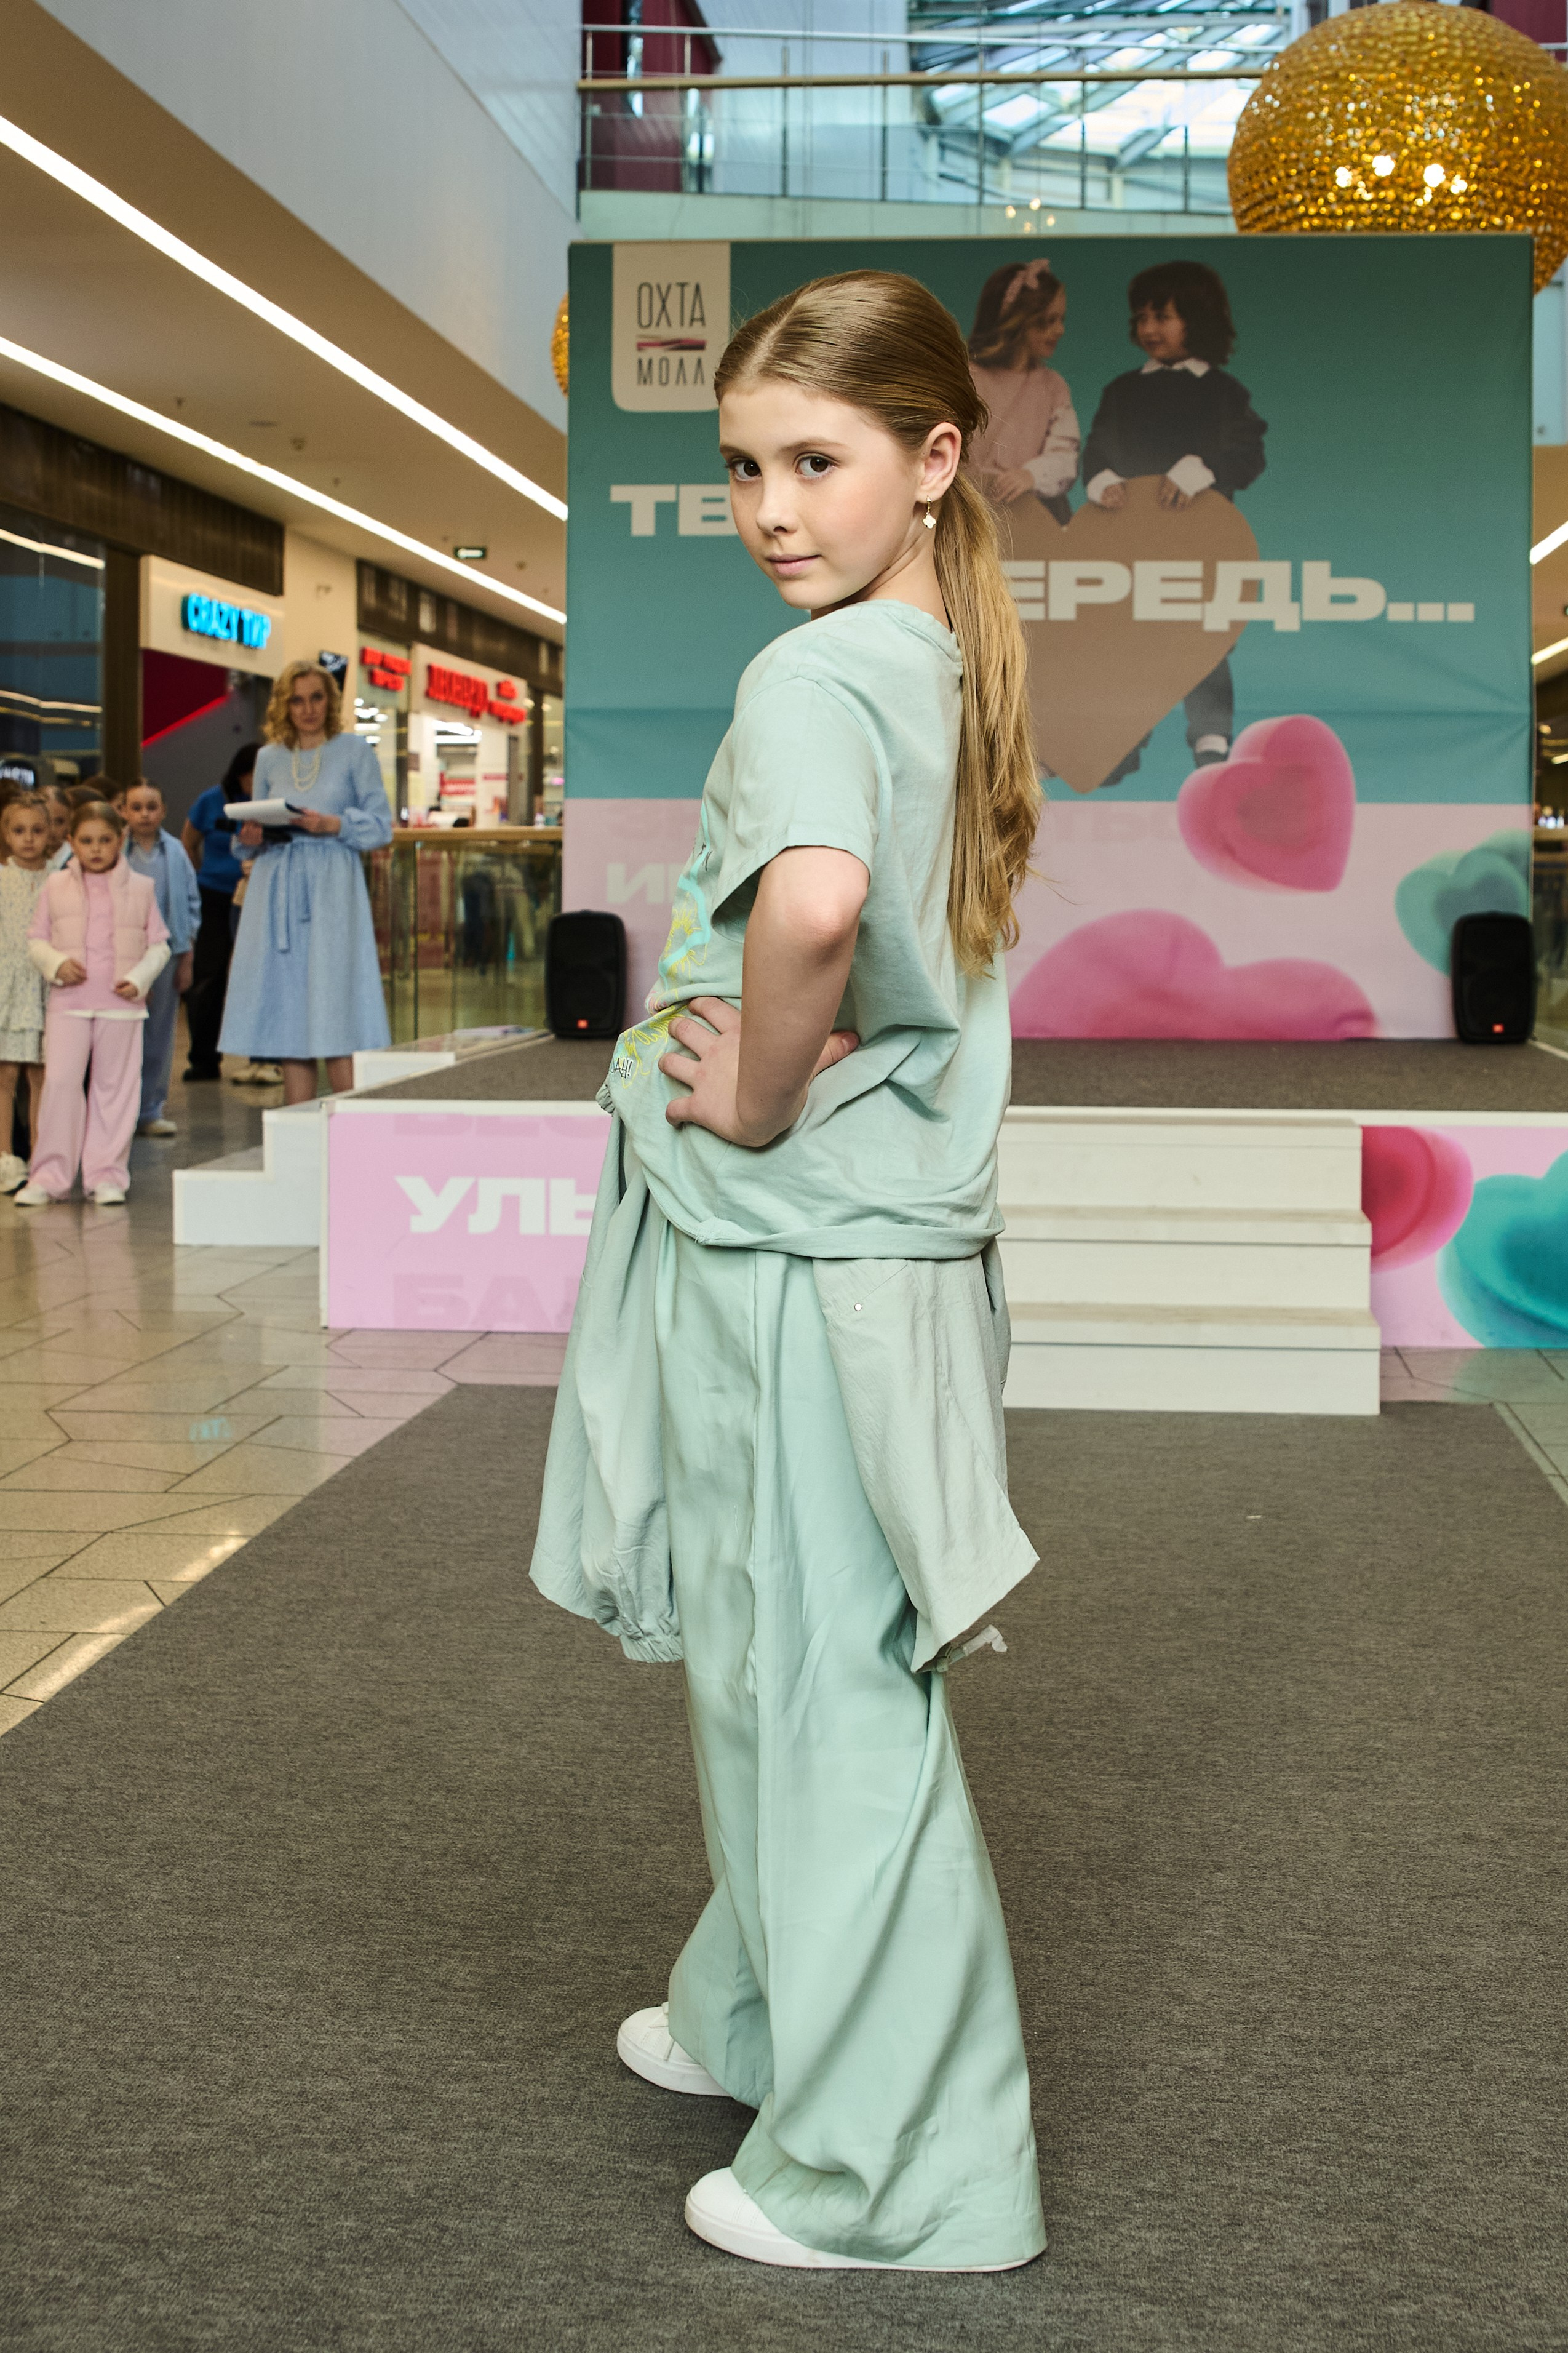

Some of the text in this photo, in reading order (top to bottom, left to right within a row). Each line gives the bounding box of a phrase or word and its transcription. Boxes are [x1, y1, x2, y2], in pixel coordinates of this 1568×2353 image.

[637, 281, 706, 329] ОХТА
[637, 356, 705, 386] МОЛЛ
[610, 484, 739, 537] ТВ
[1001, 560, 1475, 632] ЕРЕДЬ...
